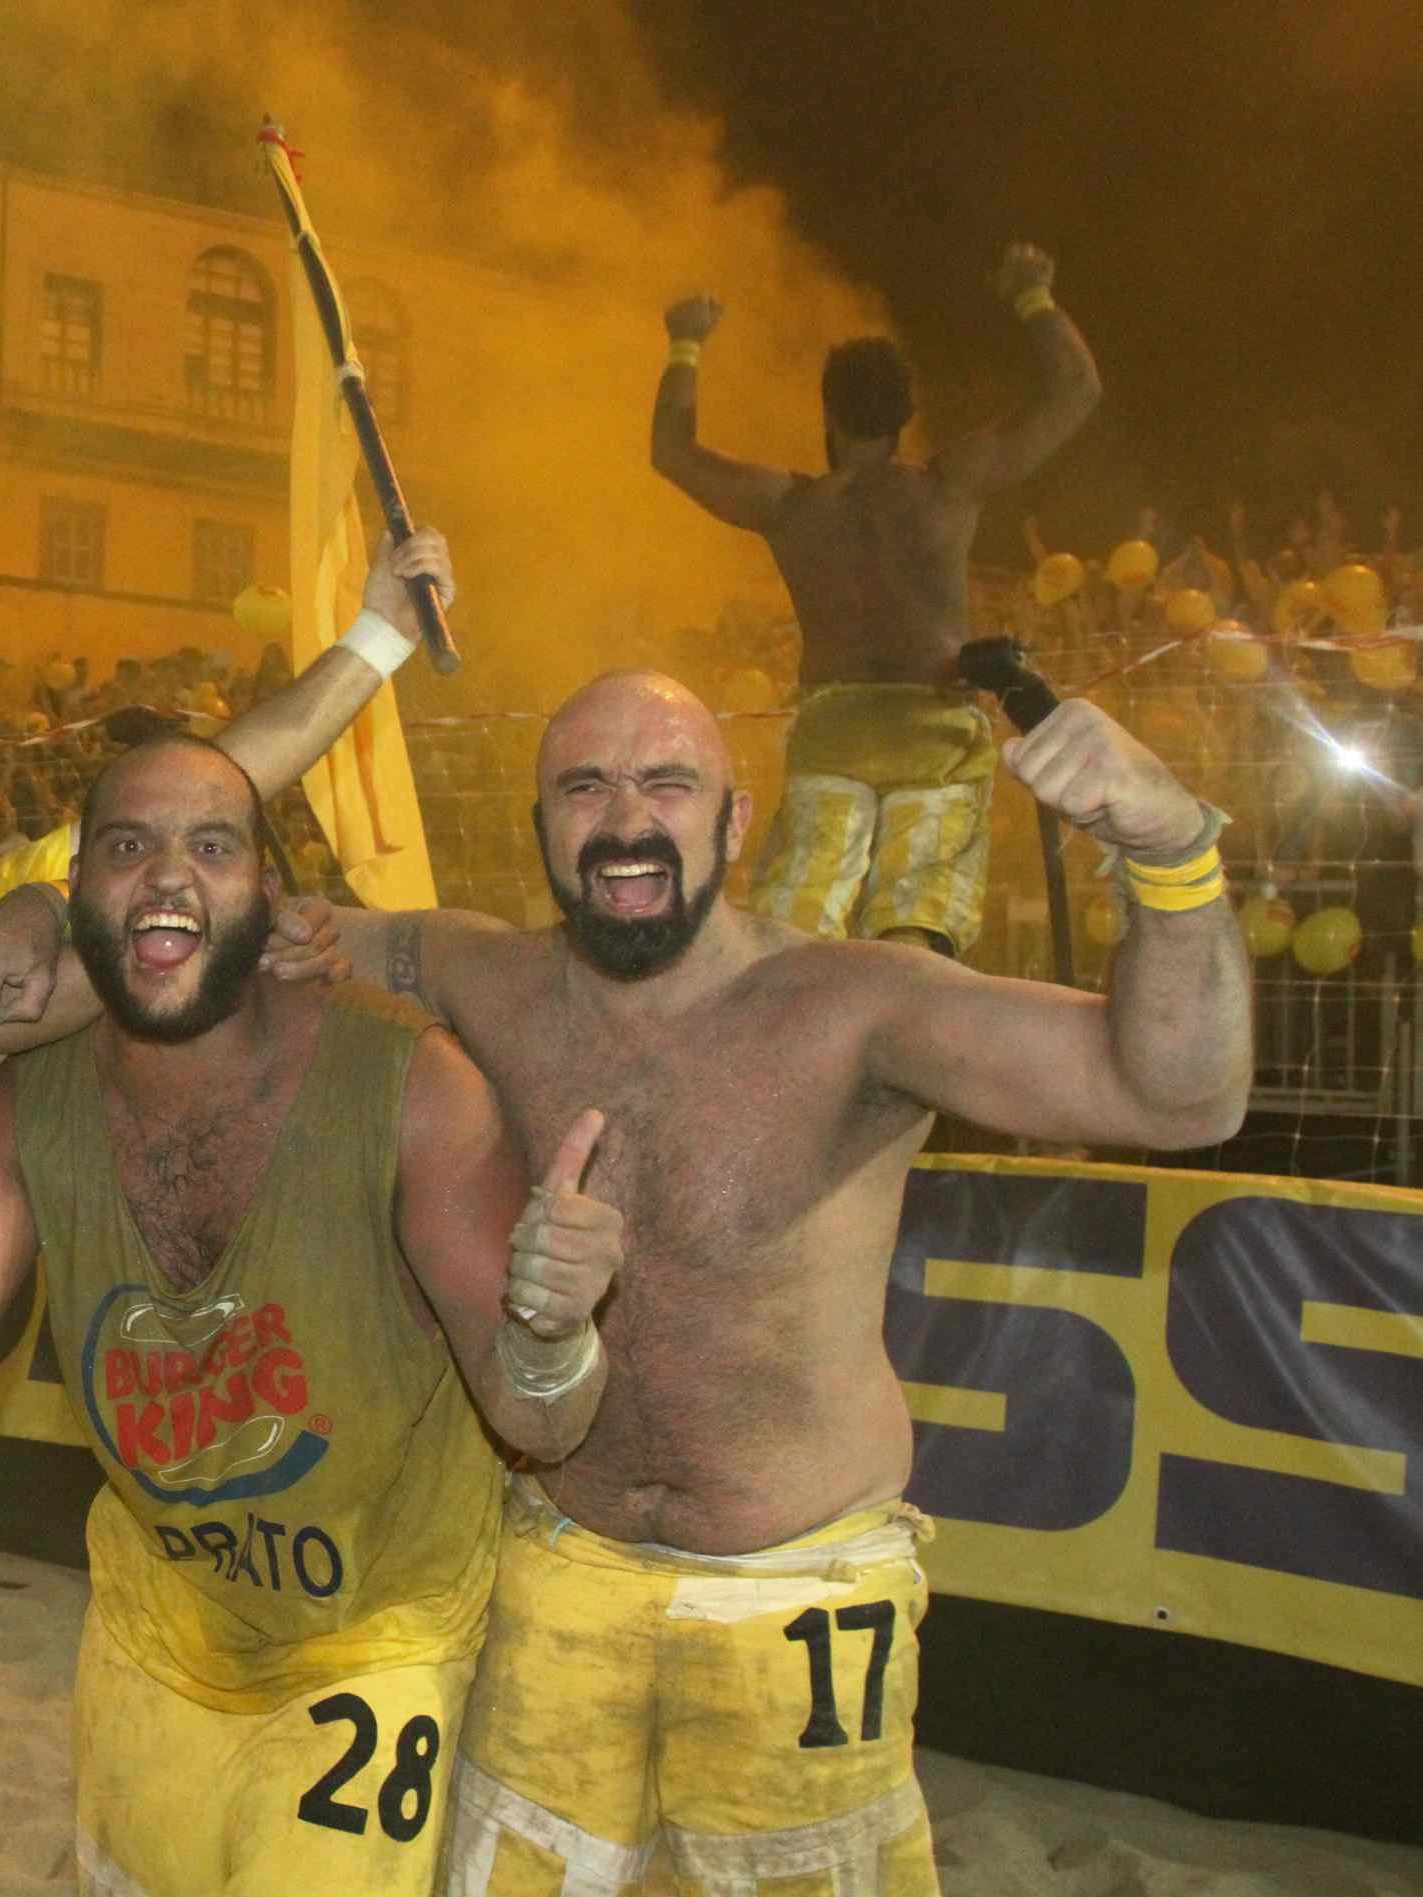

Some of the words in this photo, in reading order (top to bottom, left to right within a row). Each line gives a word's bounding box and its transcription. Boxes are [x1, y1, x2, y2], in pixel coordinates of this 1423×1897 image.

[105, 1302, 293, 1400] BURGER
[117, 1347, 309, 1468] KING
[154, 1512, 344, 1598] PRATO
[783, 1599, 896, 1748] 17
[297, 1692, 440, 1842] 28
